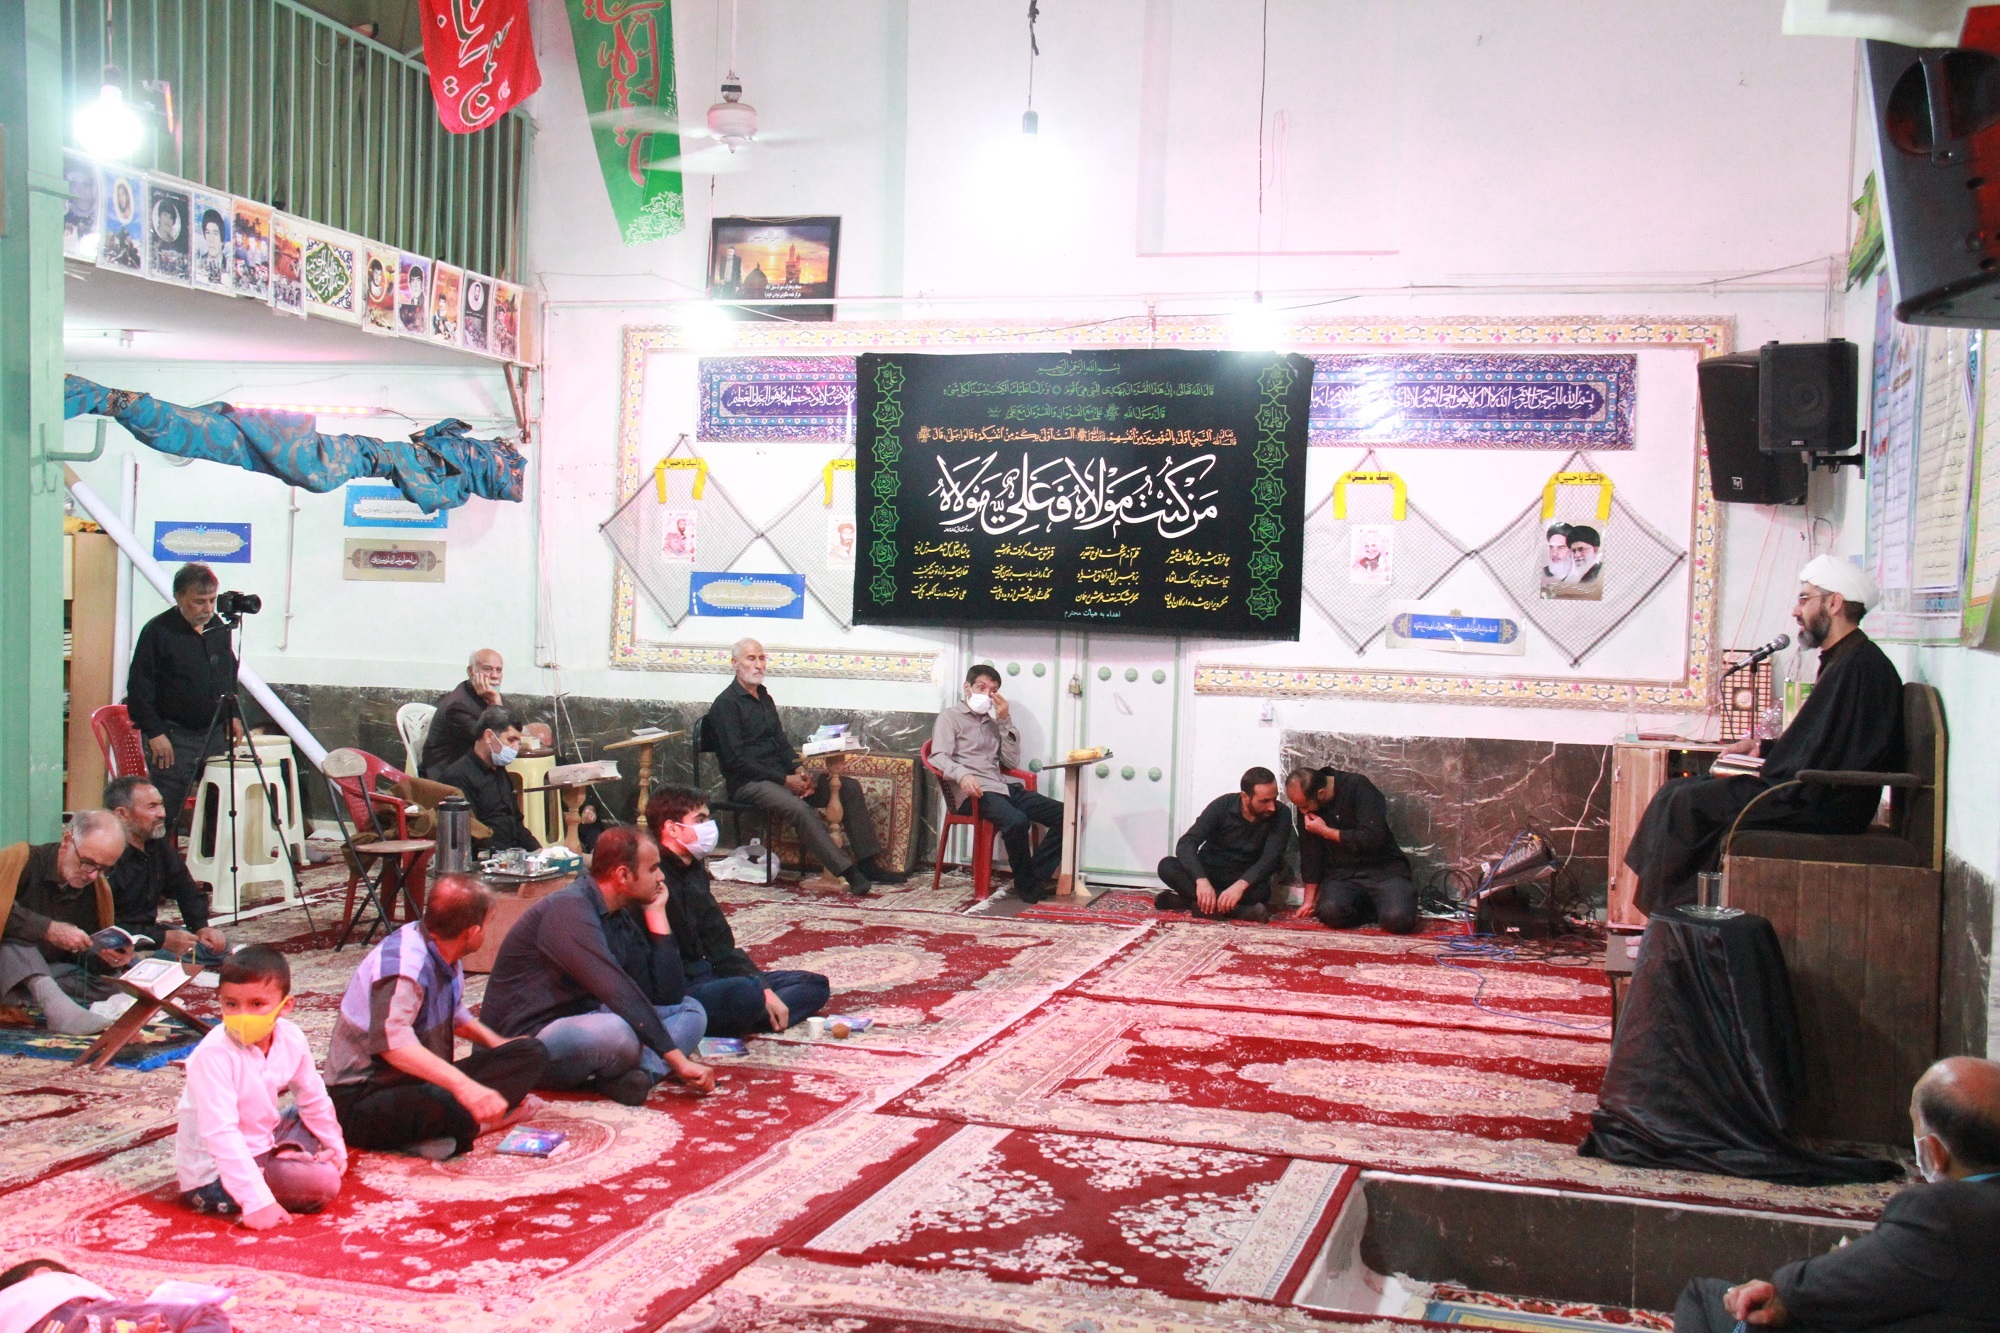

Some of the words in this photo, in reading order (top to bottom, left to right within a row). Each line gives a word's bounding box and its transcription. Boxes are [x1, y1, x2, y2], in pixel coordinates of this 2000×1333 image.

[1084, 360, 1097, 374] الله
[1096, 363, 1121, 376] بسم
[1064, 610, 1082, 618] محترم
[1100, 611, 1105, 619] به
[1106, 610, 1121, 618] اهداء
